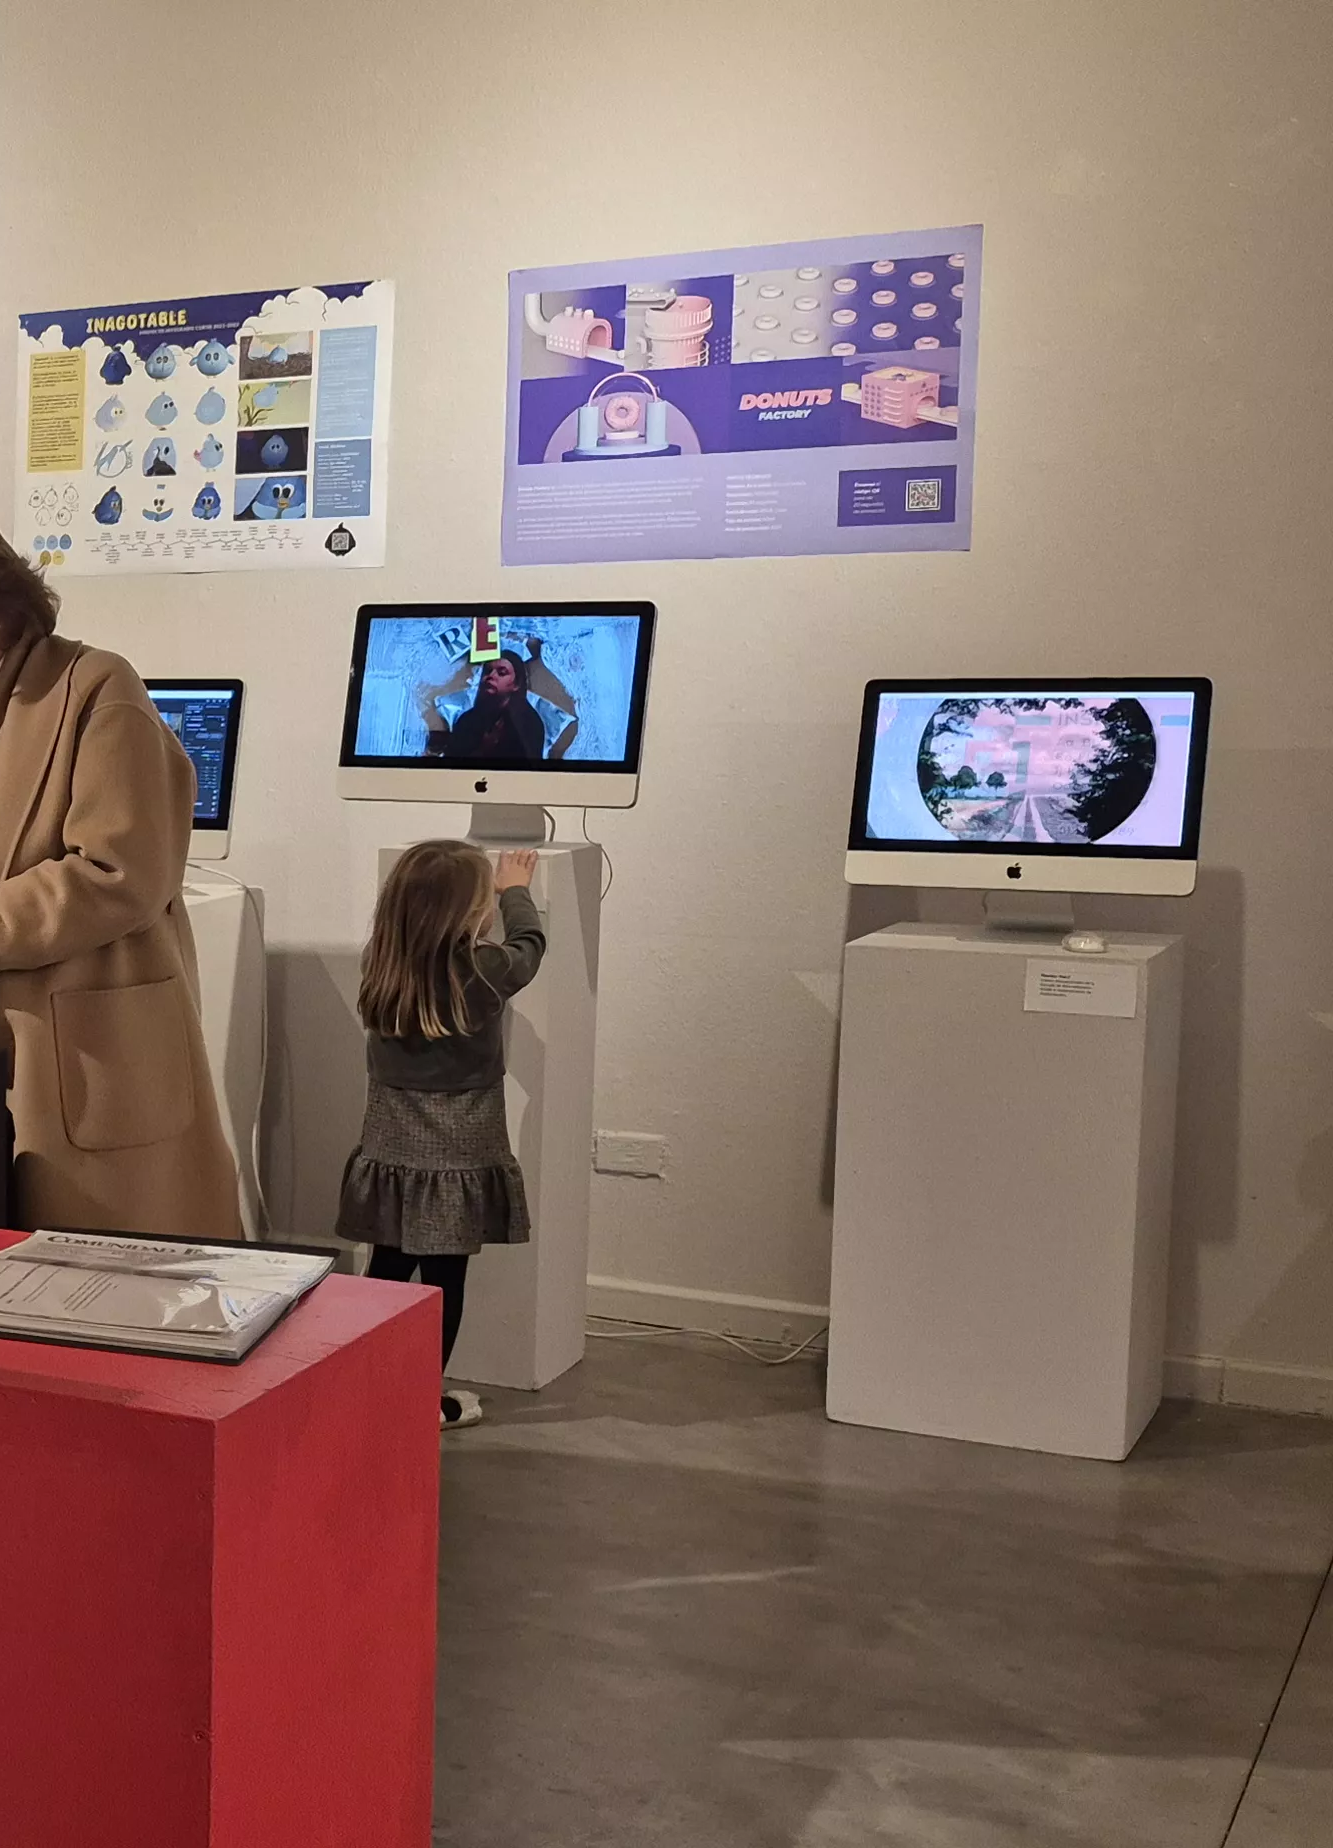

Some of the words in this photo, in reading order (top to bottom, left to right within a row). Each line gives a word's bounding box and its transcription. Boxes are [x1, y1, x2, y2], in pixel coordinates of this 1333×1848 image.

[85, 308, 188, 335] INAGOTABLE
[738, 388, 833, 412] DONUTS
[757, 408, 813, 422] FACTORY
[47, 1235, 176, 1254] COMUNIDAD
